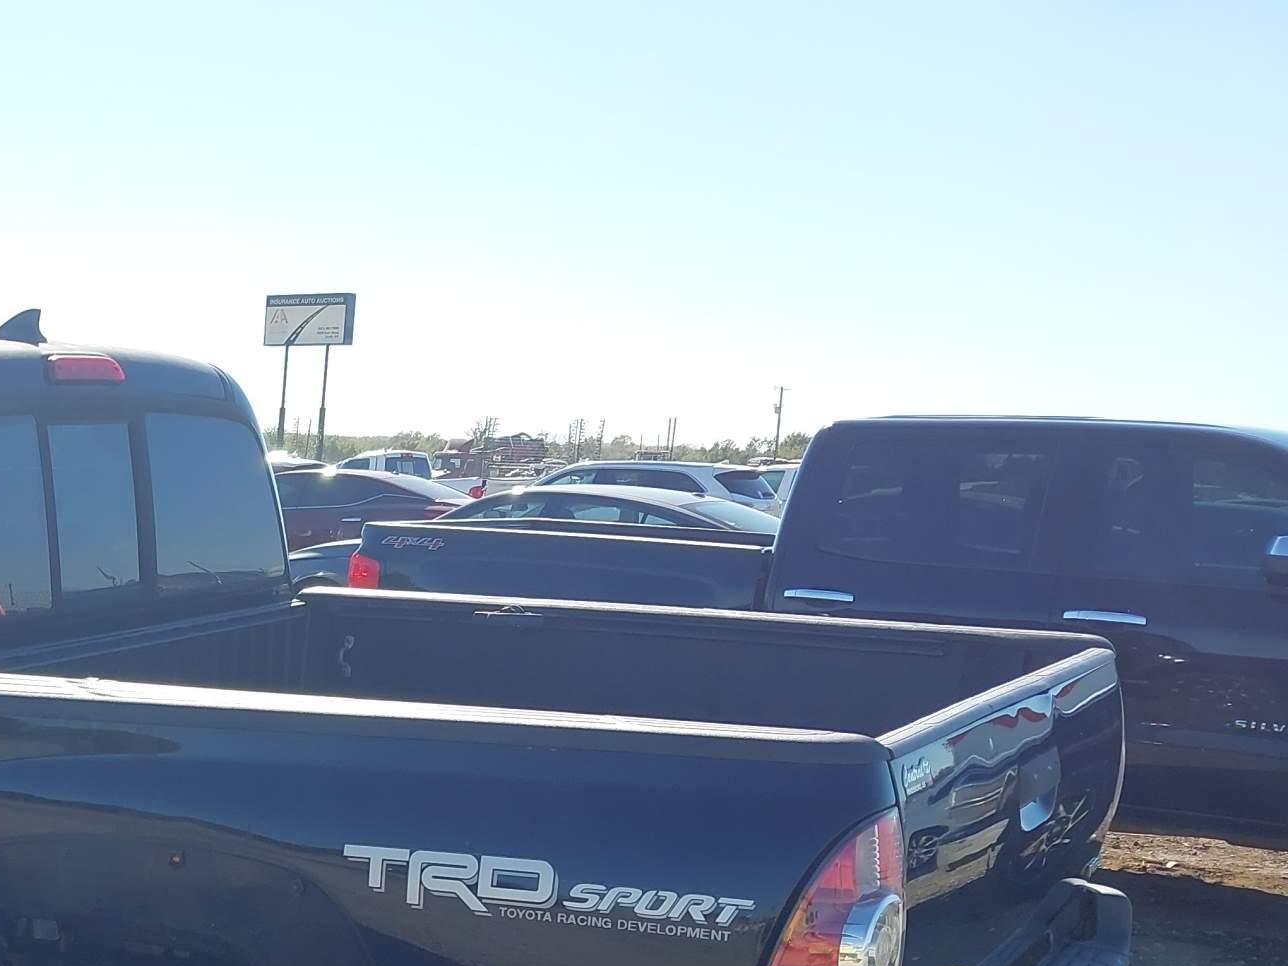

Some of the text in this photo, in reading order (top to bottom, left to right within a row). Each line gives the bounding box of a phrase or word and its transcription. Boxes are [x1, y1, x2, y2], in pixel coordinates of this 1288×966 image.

[343, 844, 756, 927] TRD SPORT
[499, 906, 732, 942] TOYOTA RACING DEVELOPMENT
